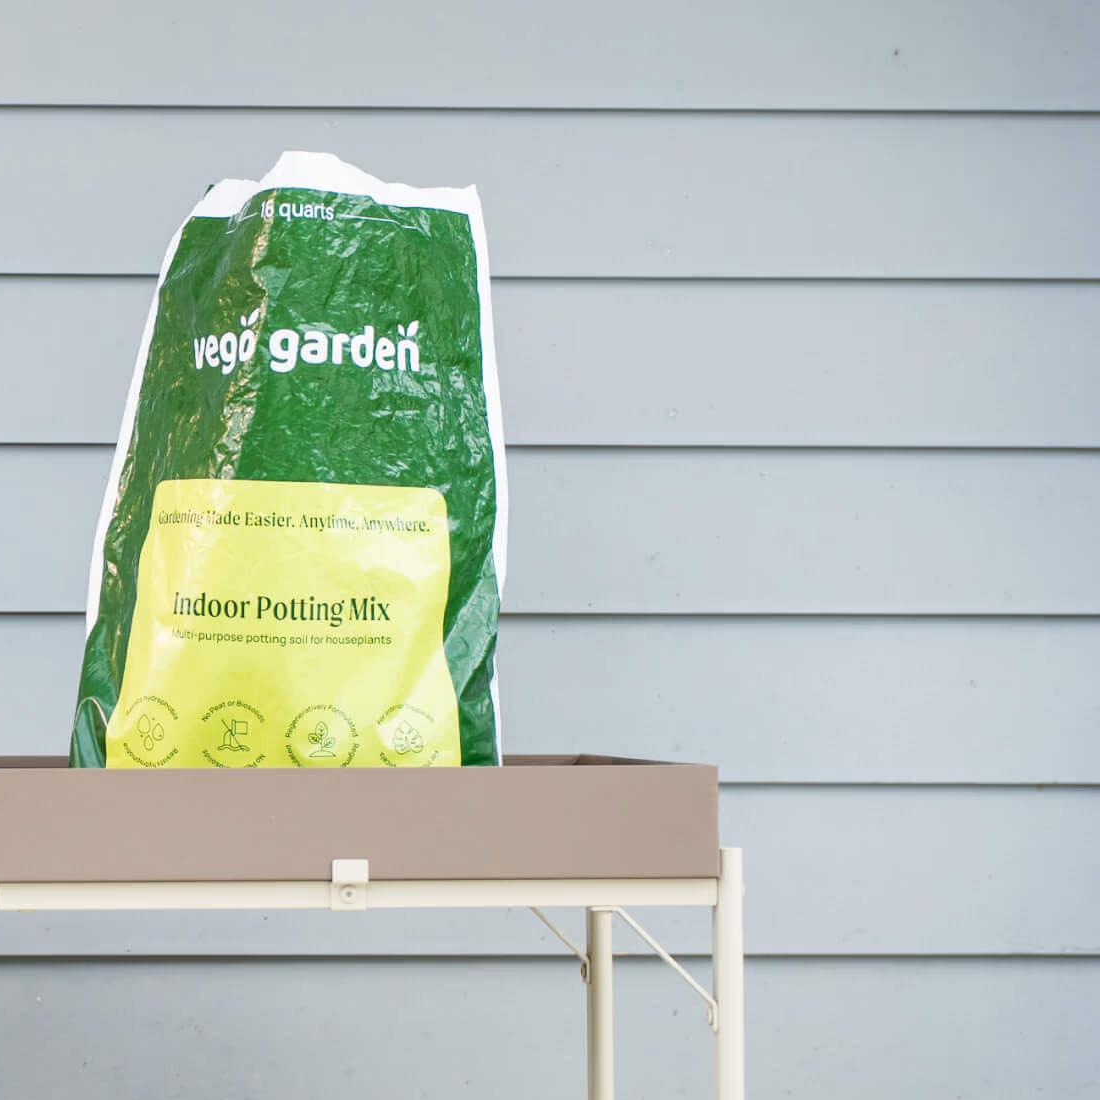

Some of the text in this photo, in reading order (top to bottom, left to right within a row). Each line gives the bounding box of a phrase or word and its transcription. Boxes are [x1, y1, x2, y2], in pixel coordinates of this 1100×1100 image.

[261, 200, 335, 223] 16 quarts
[194, 308, 420, 375] vego garden
[158, 509, 203, 528] Gardening
[245, 511, 296, 528] Easier.
[361, 516, 431, 534] Anywhere.
[173, 592, 390, 627] Indoor Potting Mix
[172, 628, 392, 647] Multi-purpose potting soil for houseplants
